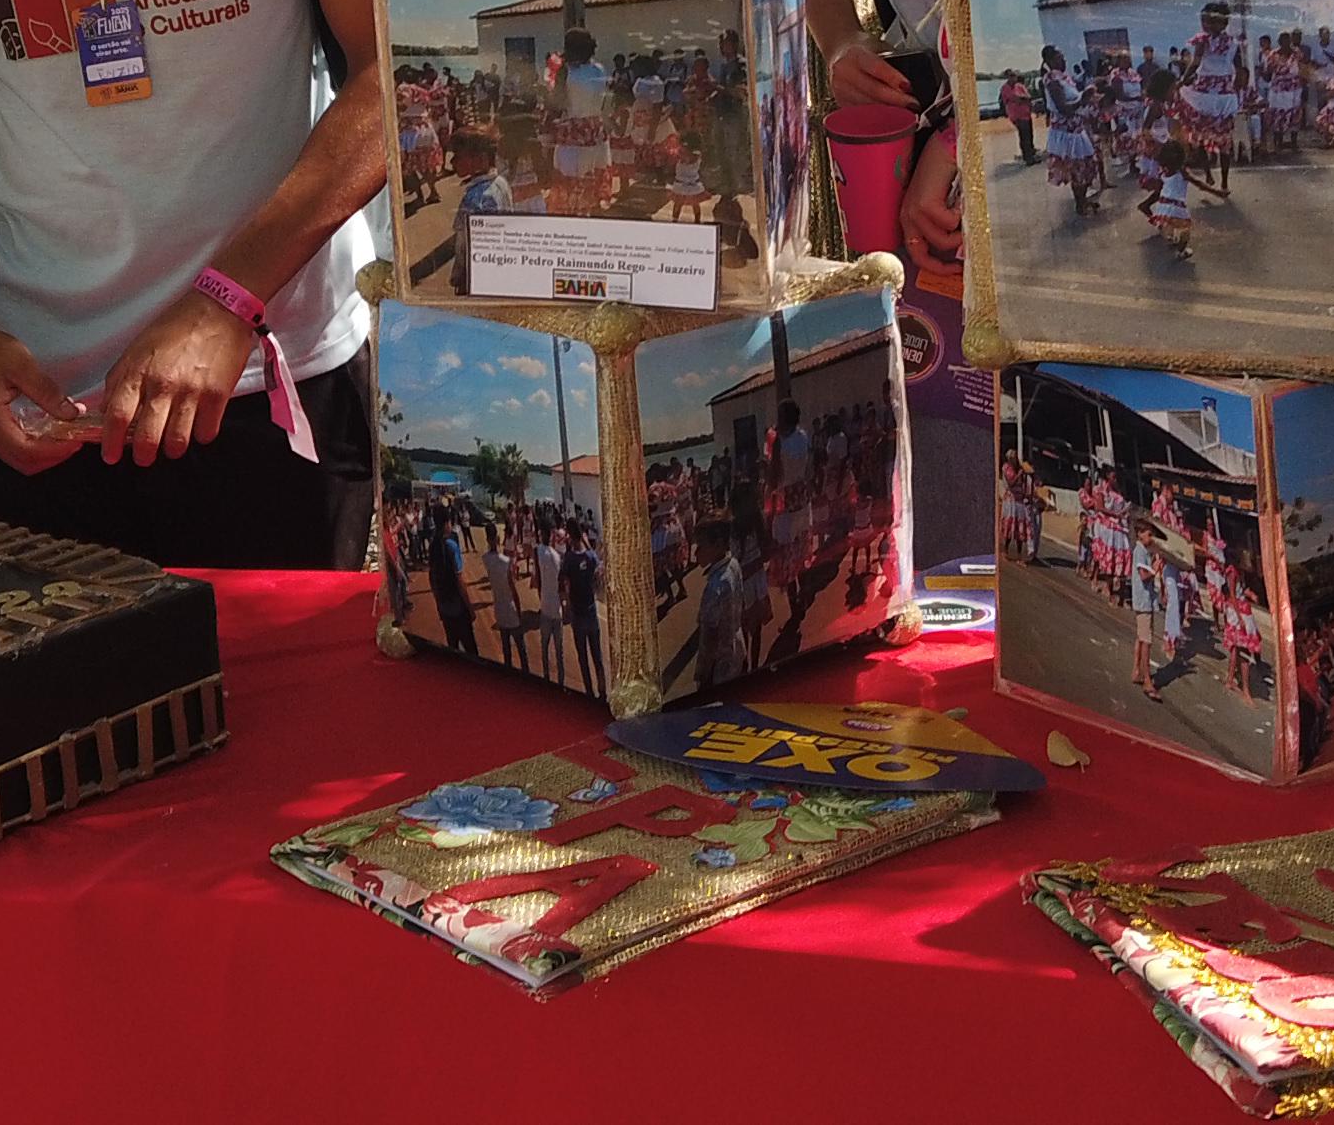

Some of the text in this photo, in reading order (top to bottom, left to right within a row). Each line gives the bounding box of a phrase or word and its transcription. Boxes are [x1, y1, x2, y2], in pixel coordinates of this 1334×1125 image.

[472, 253, 517, 266] Colégio:
[521, 255, 553, 266] Pedro
[557, 257, 614, 270] Raimundo
[618, 260, 645, 273] Rego
[657, 263, 705, 275] Juazeiro
[555, 279, 606, 297] BAHIA
